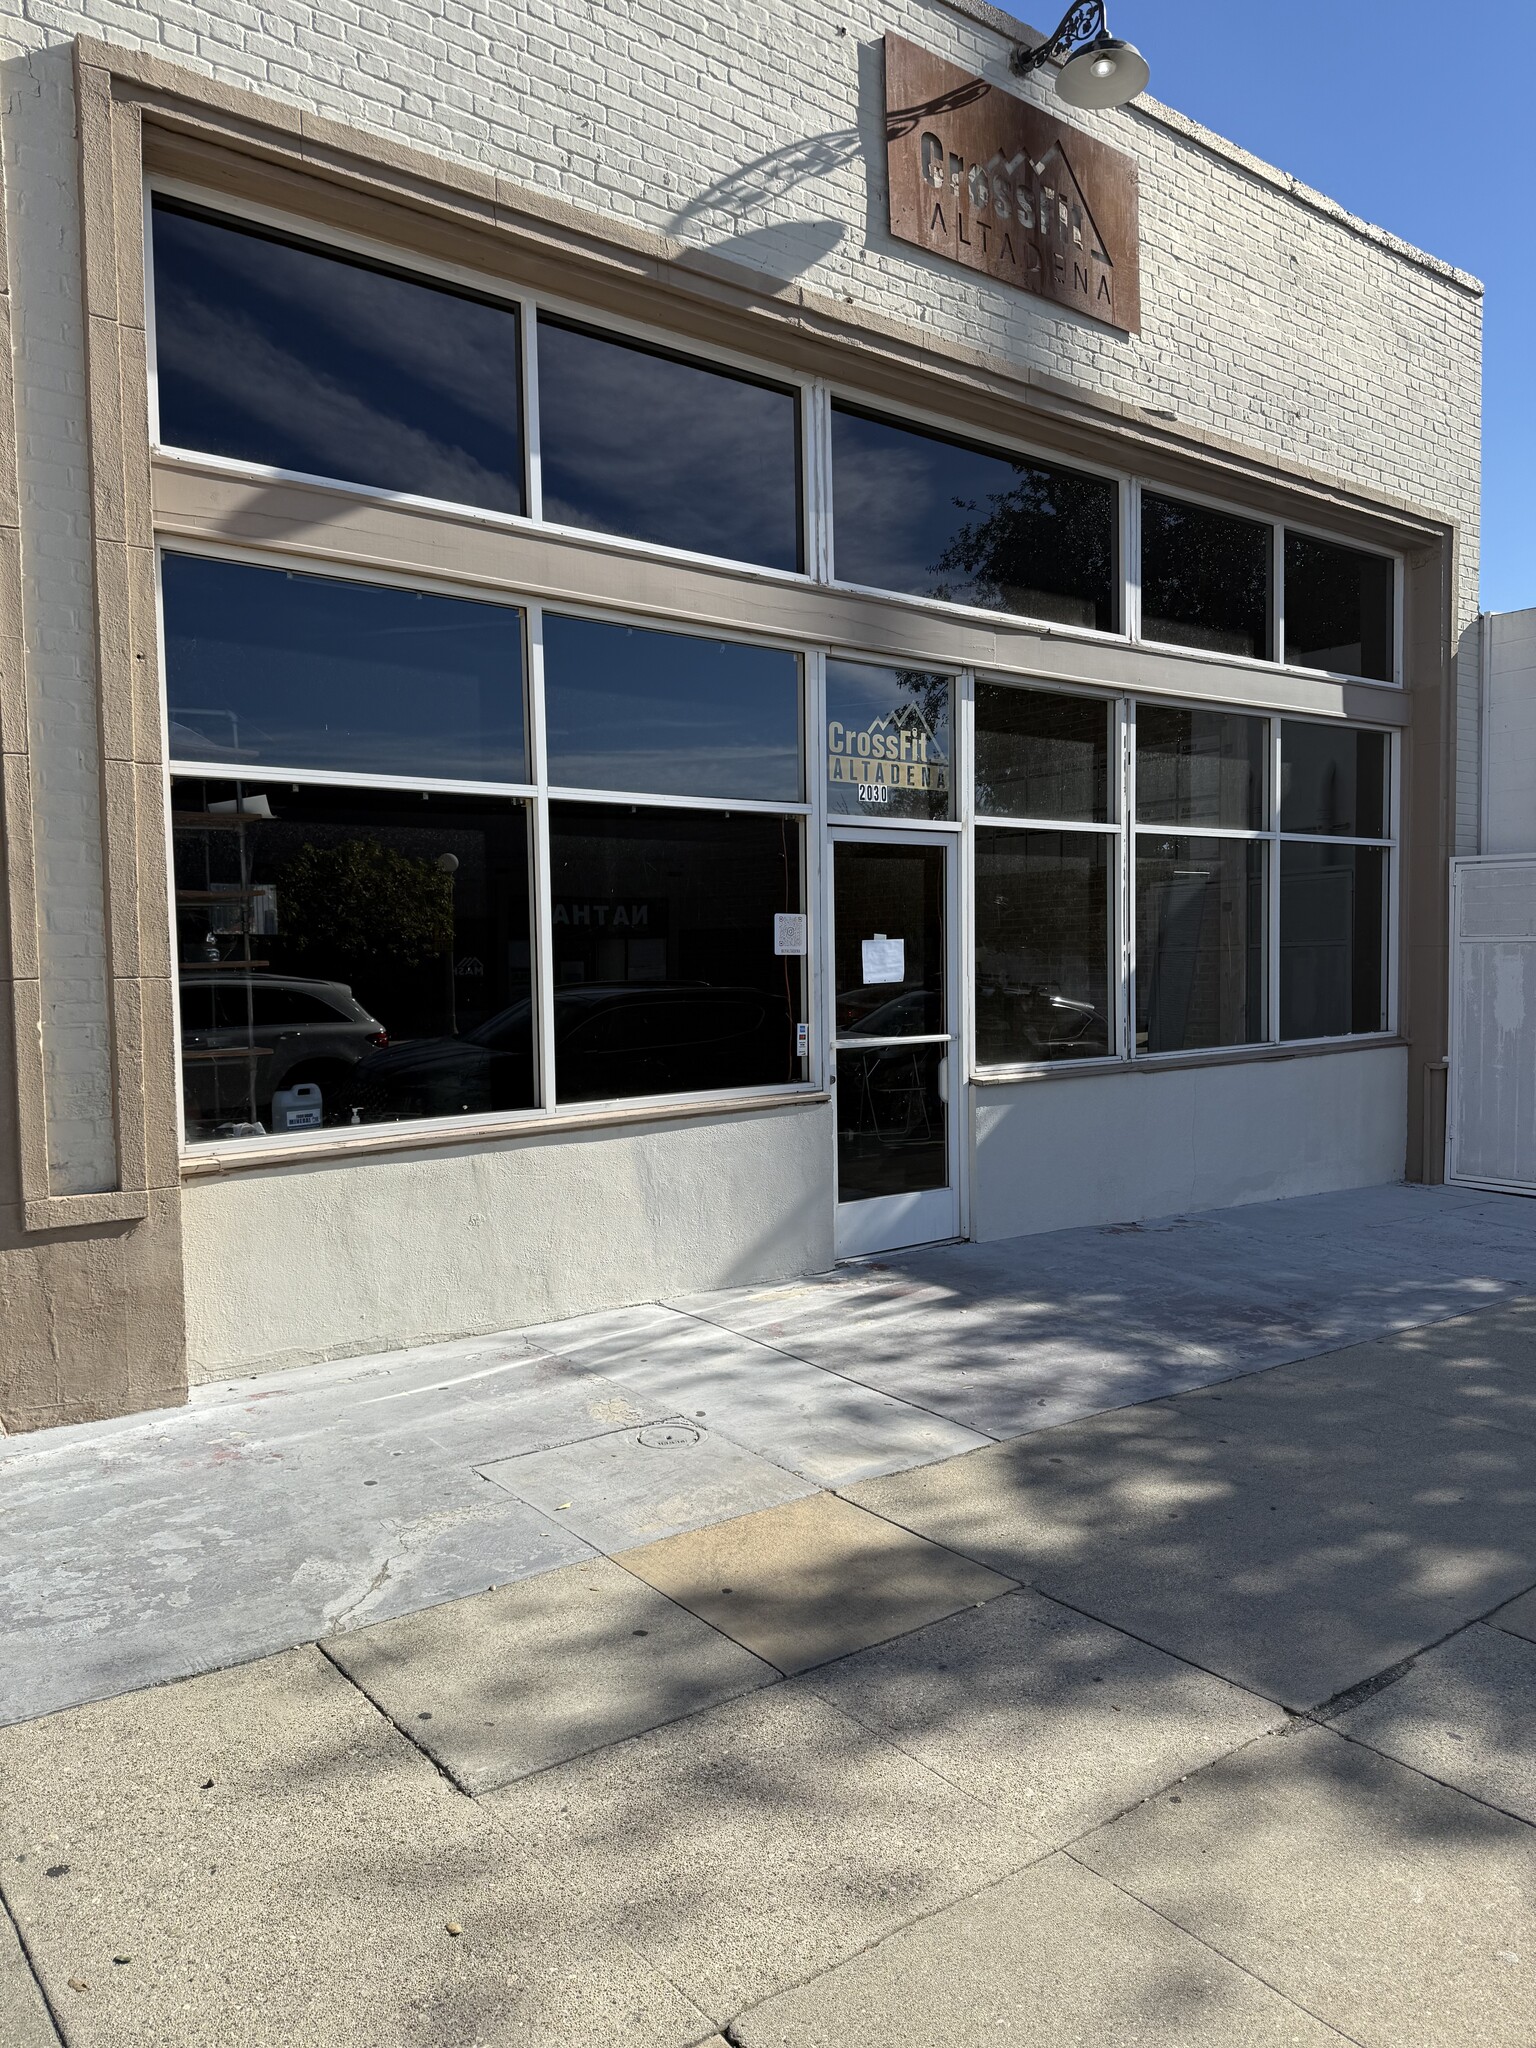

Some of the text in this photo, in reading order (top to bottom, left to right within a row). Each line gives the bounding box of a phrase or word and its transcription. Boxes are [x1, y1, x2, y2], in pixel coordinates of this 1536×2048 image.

[921, 131, 1084, 252] CrossFit
[930, 202, 1112, 305] ALTADENA
[828, 721, 928, 763] CrossFit
[833, 757, 946, 789] ALTADENA
[859, 784, 887, 802] 2030
